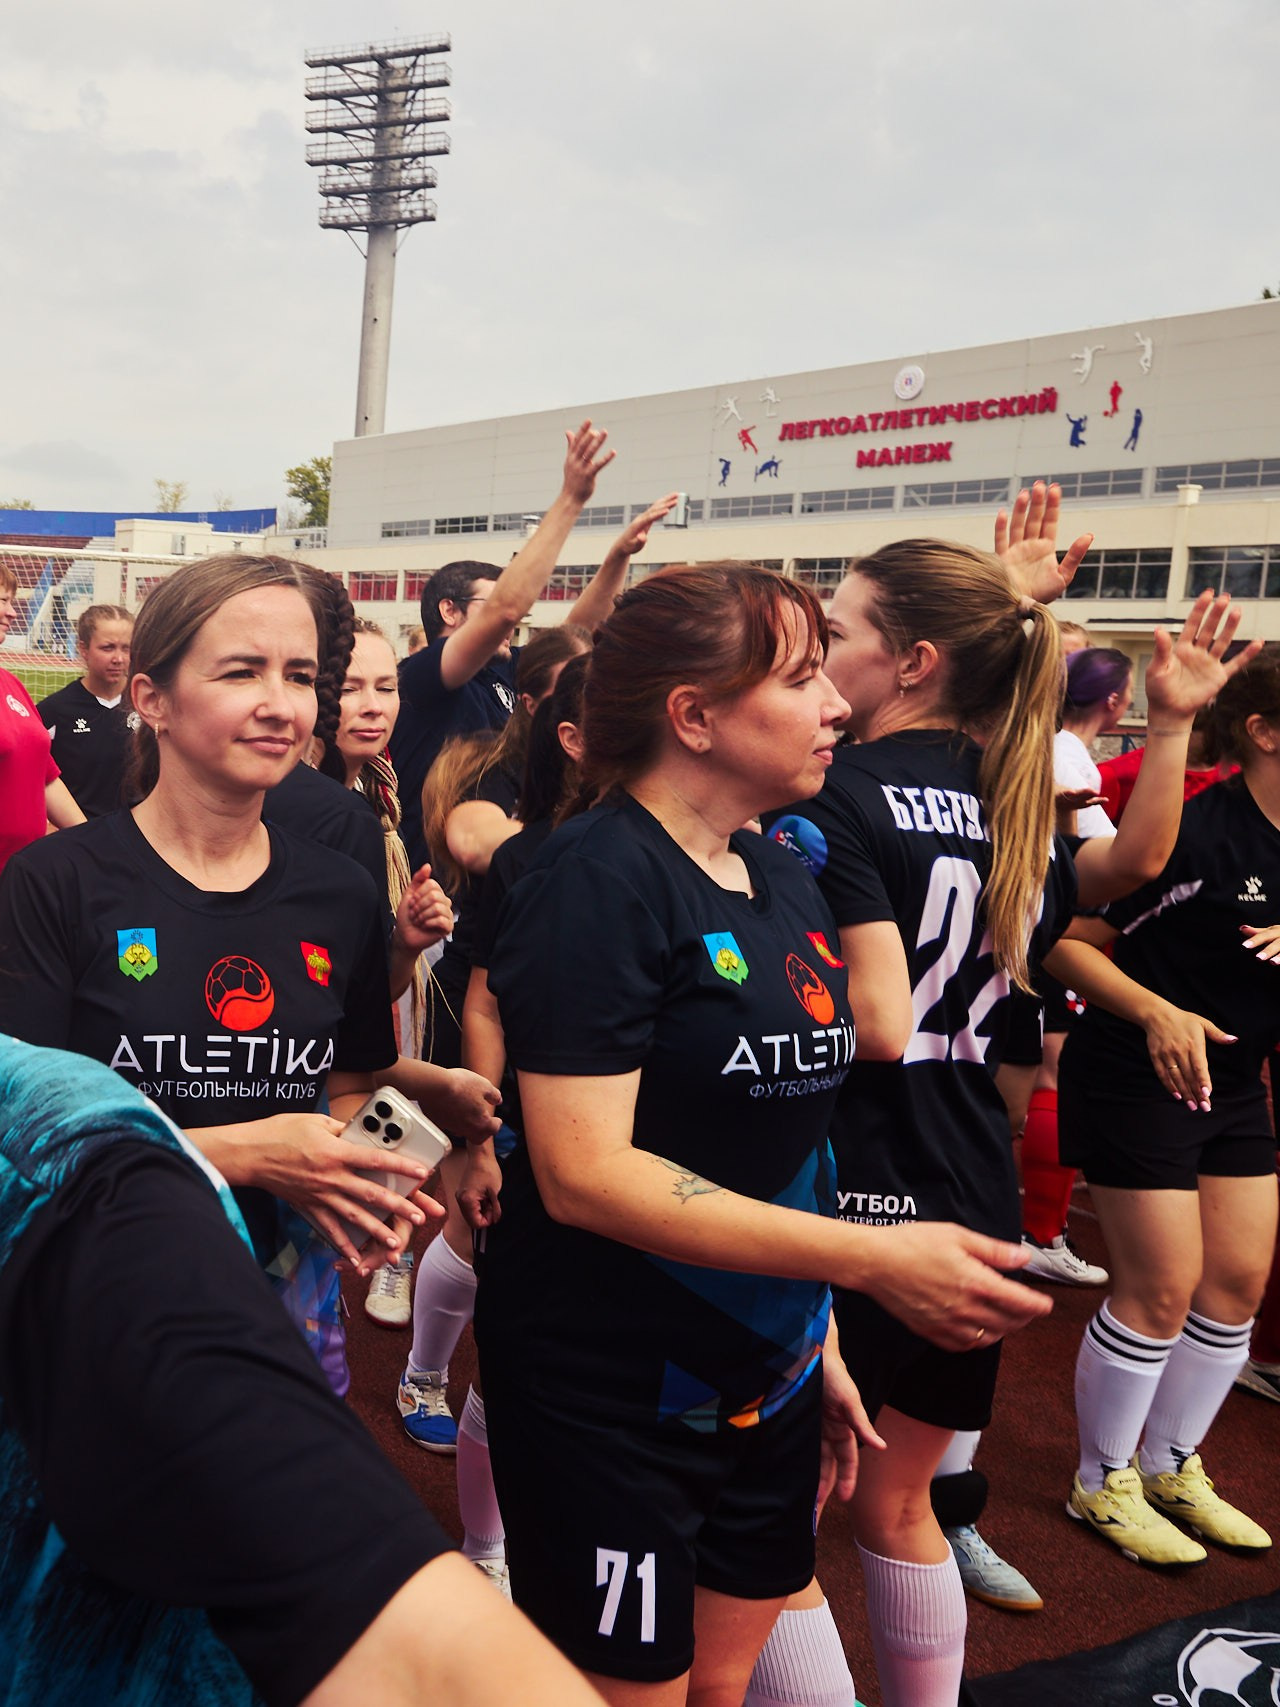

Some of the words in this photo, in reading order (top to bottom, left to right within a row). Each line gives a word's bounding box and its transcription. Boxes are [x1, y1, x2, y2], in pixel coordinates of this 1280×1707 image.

[778, 387, 1058, 442] ЛЕГКОАТЛЕТИЧЕСКИЙ
[856, 441, 953, 469] МАНЕЖ
[881, 784, 991, 842] БЕСТУ
[903, 856, 1044, 1064] 22
[138, 1078, 269, 1099] ФУТБОЛЬНЫЙ
[275, 1081, 316, 1099] КЛУБ
[836, 1190, 917, 1215] УТБОЛ
[596, 1547, 656, 1643] 71
